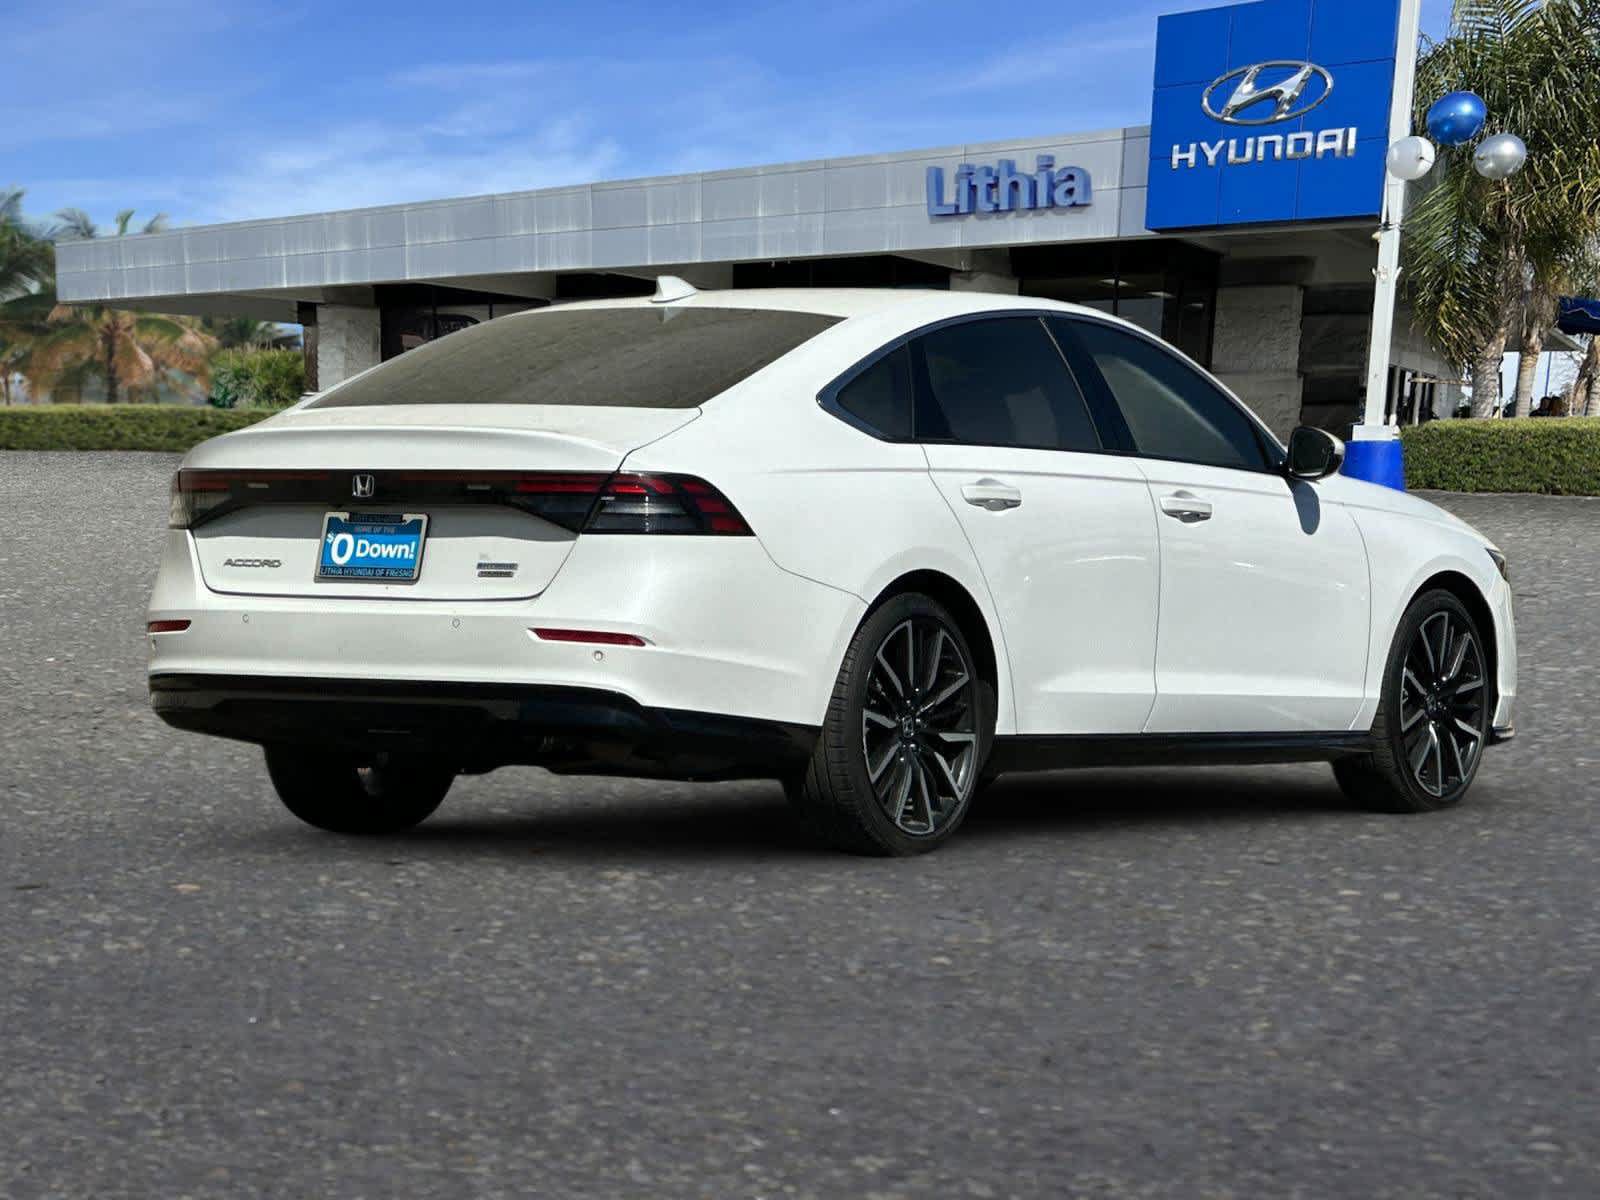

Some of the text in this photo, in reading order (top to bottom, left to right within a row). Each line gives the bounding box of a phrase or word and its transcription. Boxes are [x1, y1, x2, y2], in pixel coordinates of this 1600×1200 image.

[1171, 127, 1357, 169] HYUNDAI
[925, 154, 1093, 217] Lithia
[355, 539, 416, 560] Down!
[223, 558, 282, 568] ACCORD
[319, 567, 414, 579] LITHIA HYUNDAI OF FRESNO
